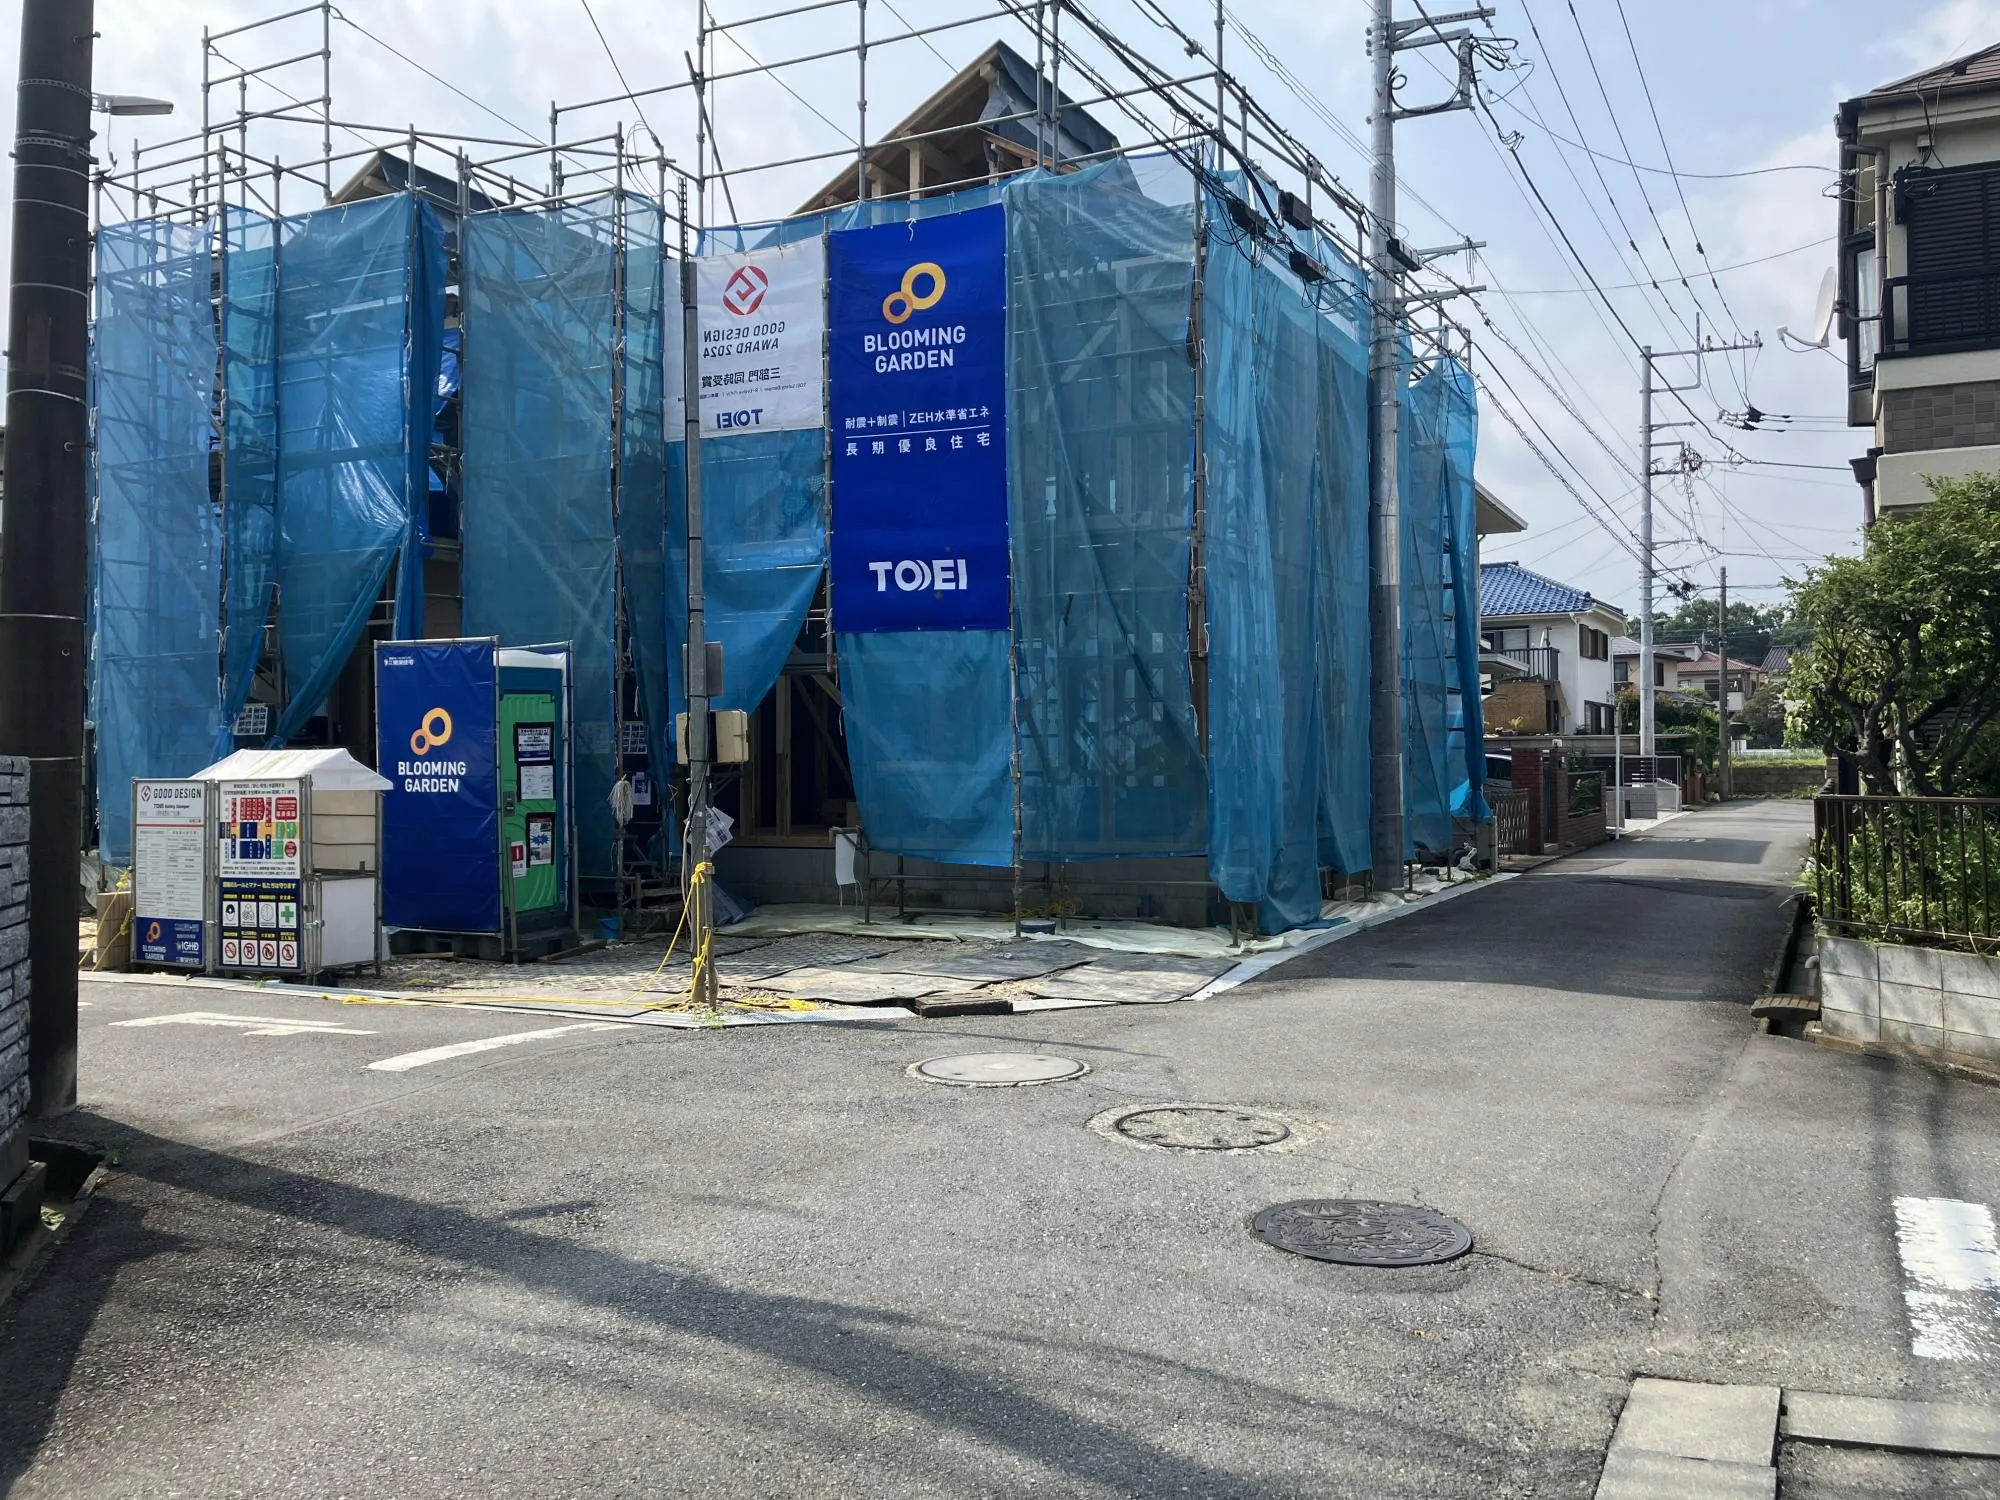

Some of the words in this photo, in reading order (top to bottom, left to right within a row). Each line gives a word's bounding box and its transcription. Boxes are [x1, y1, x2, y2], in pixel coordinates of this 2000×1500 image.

[864, 325, 966, 352] BLOOMING
[875, 349, 954, 373] GARDEN
[909, 406, 989, 424] ZEH水準省エネ
[846, 431, 990, 456] 長期優良住宅
[868, 559, 968, 592] TOEI
[398, 761, 466, 776] BLOOMING
[153, 788, 173, 799] GOOD
[174, 788, 202, 799] DESIGN
[405, 778, 459, 793] GARDEN
